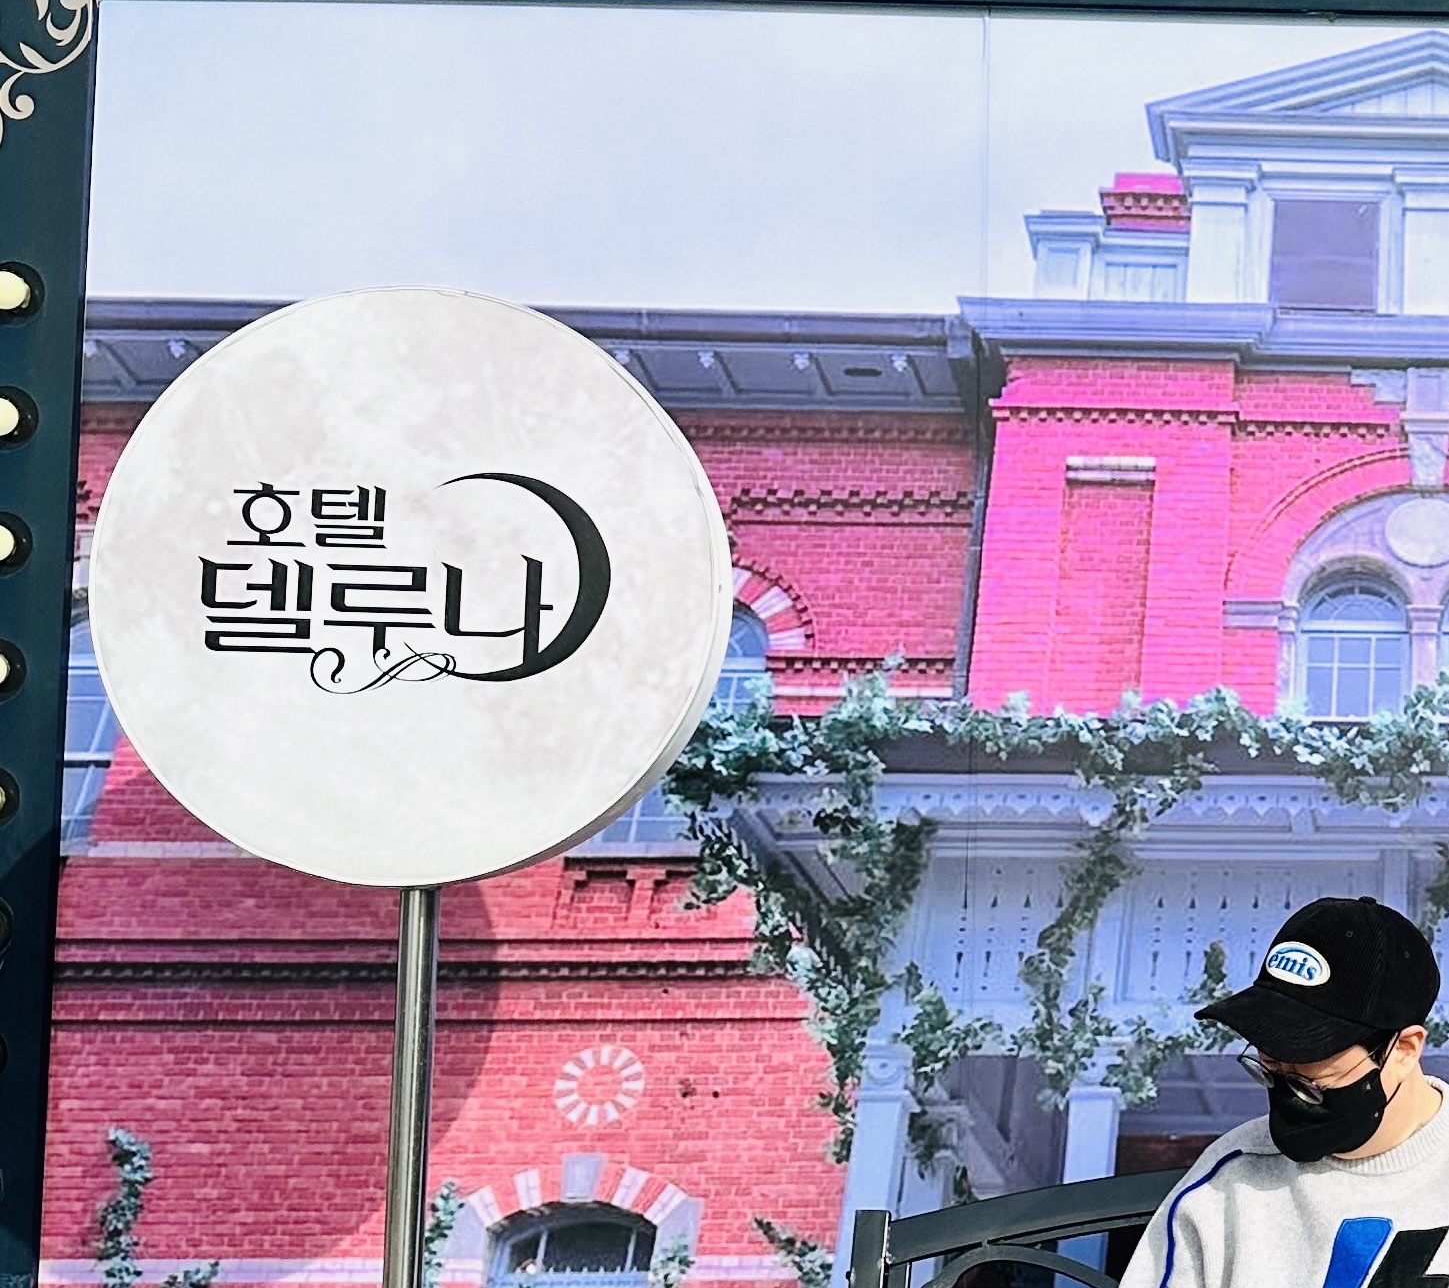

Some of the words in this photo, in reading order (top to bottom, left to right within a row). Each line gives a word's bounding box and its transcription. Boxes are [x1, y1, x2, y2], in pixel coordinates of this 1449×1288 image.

[226, 481, 388, 549] 호텔
[198, 555, 604, 692] 델루나
[1267, 953, 1317, 982] emis
